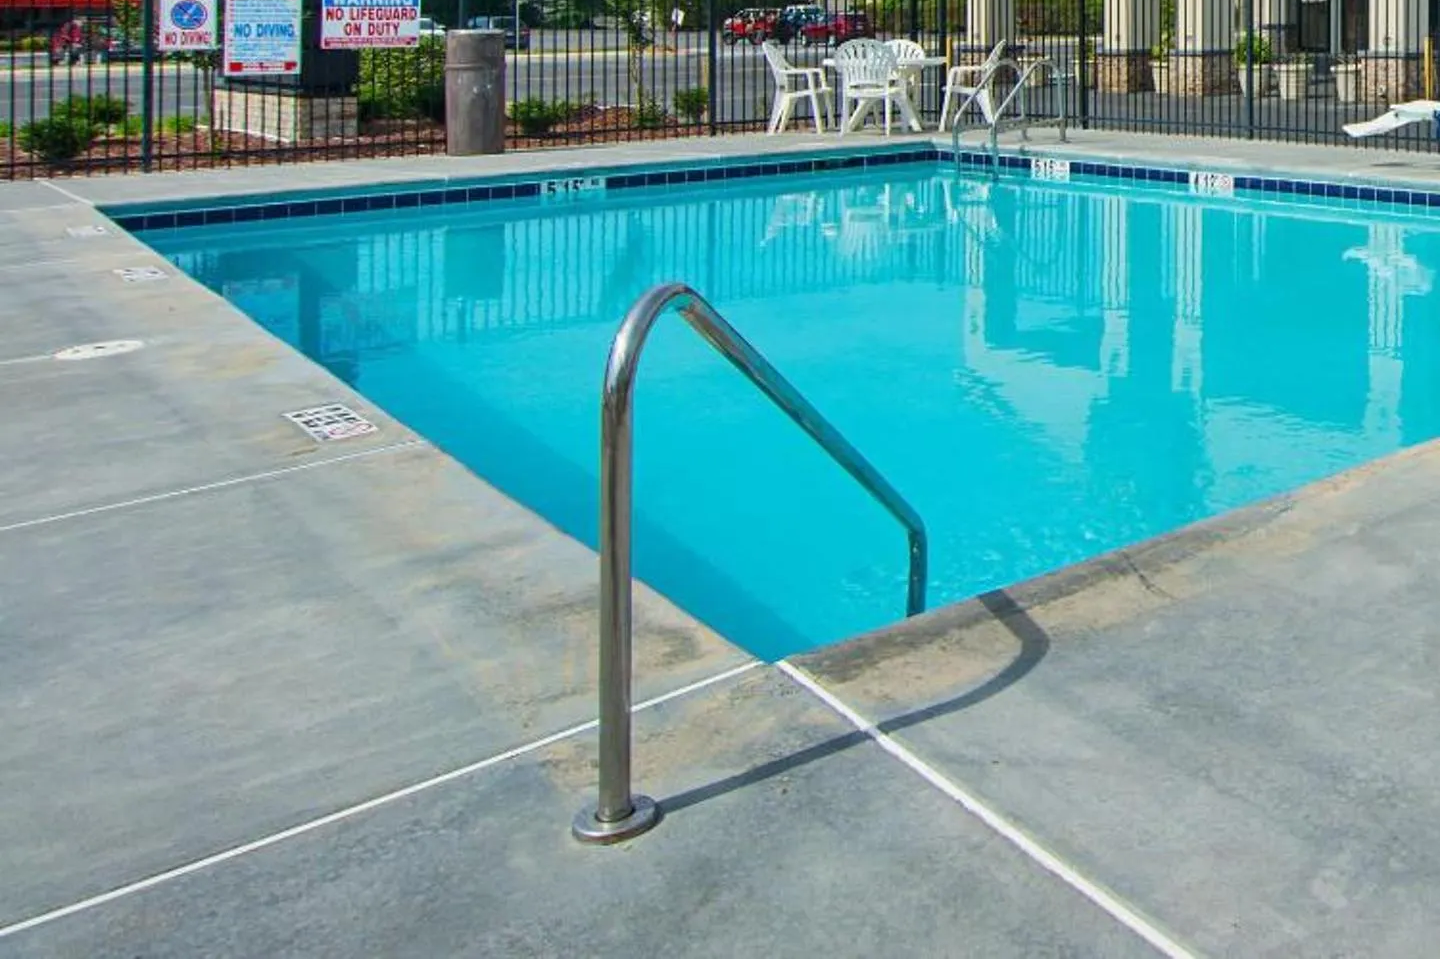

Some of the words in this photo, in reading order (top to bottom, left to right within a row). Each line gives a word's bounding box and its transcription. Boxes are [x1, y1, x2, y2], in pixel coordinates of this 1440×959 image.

[326, 8, 344, 21] NO
[350, 8, 417, 21] LIFEGUARD
[234, 23, 252, 38] NO
[256, 23, 295, 38] DIVING
[343, 22, 362, 36] ON
[368, 22, 400, 36] DUTY
[164, 31, 178, 46] NO
